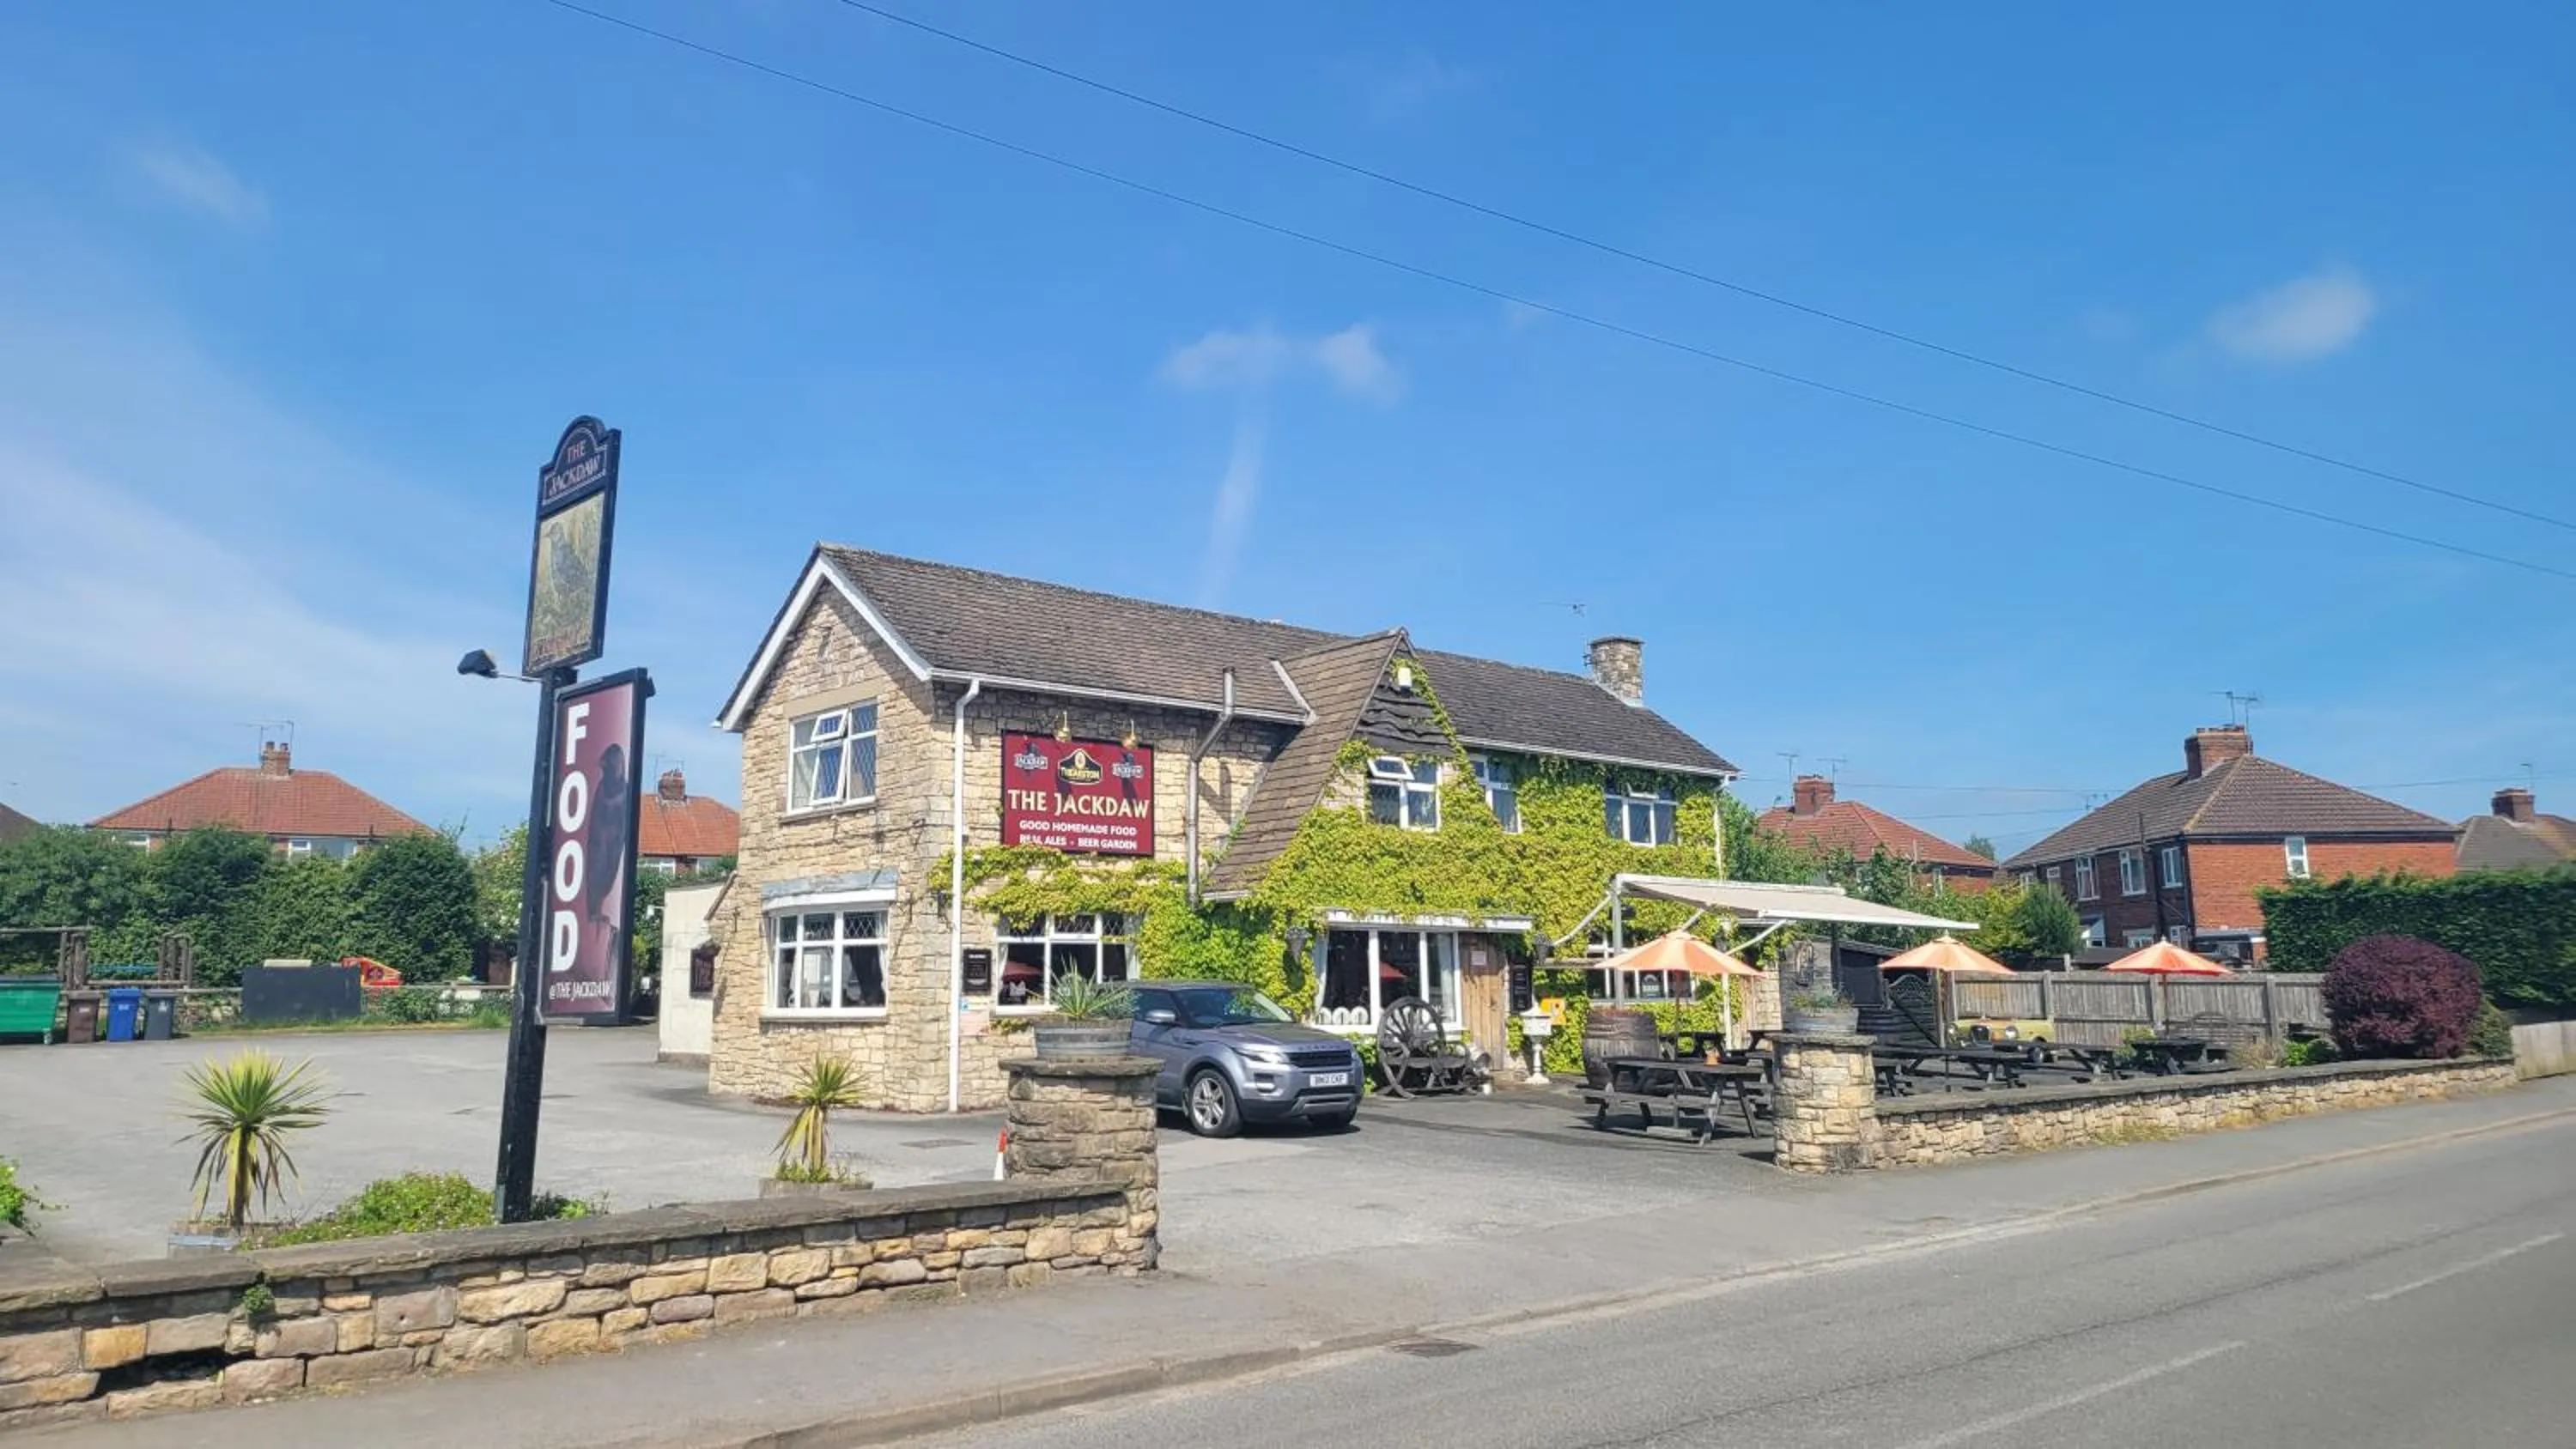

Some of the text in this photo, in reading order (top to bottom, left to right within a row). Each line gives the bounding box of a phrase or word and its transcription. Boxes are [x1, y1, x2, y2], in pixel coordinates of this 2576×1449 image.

[567, 440, 586, 464] THE
[1007, 789, 1150, 819] THE JACKDAW
[550, 701, 591, 973] FOOD
[1019, 820, 1138, 836] GOOD HOMEMADE FOOD
[1044, 835, 1066, 846] ALES
[1078, 838, 1099, 847] BEER
[1100, 840, 1137, 850] GARDEN
